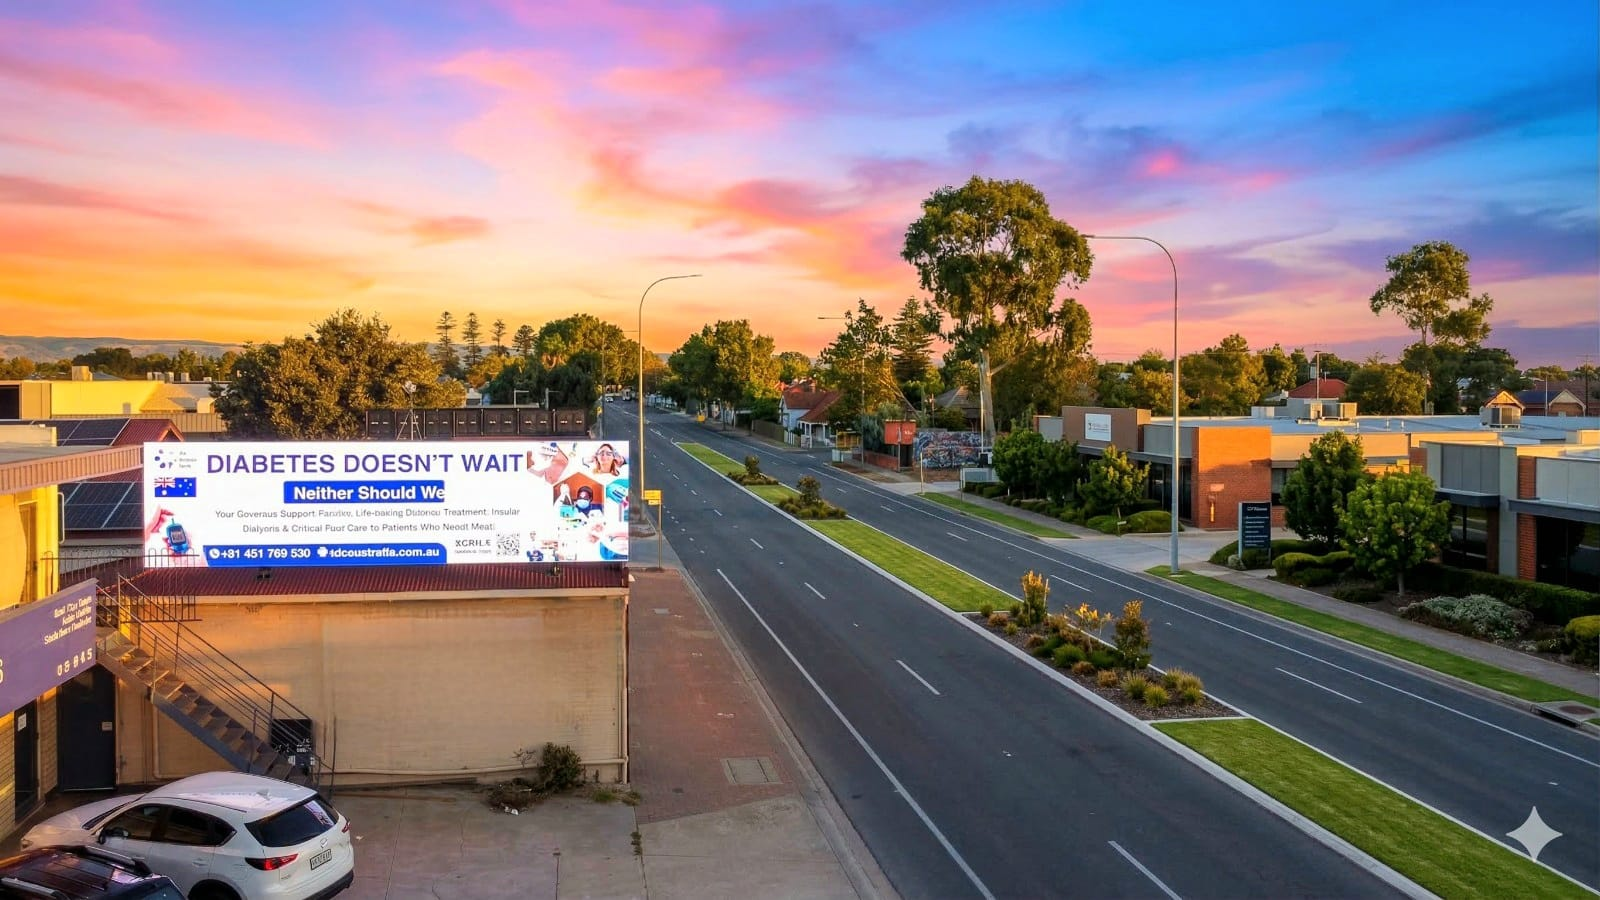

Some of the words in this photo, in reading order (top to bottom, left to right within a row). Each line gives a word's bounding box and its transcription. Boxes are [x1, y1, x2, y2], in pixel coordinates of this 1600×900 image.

[207, 454, 335, 474] DIABETES
[460, 453, 524, 473] WAIT
[293, 485, 354, 500] Neither
[358, 485, 416, 500] Should
[420, 485, 445, 500] We
[215, 510, 235, 518] Your
[280, 509, 316, 520] Support
[282, 524, 289, 533] &
[291, 523, 323, 533] Critical
[346, 523, 368, 533] Care
[370, 524, 380, 532] to
[381, 523, 418, 532] Patients
[420, 522, 441, 532] Who
[244, 548, 263, 559] 451
[267, 548, 288, 558] 769
[290, 548, 311, 558] 530
